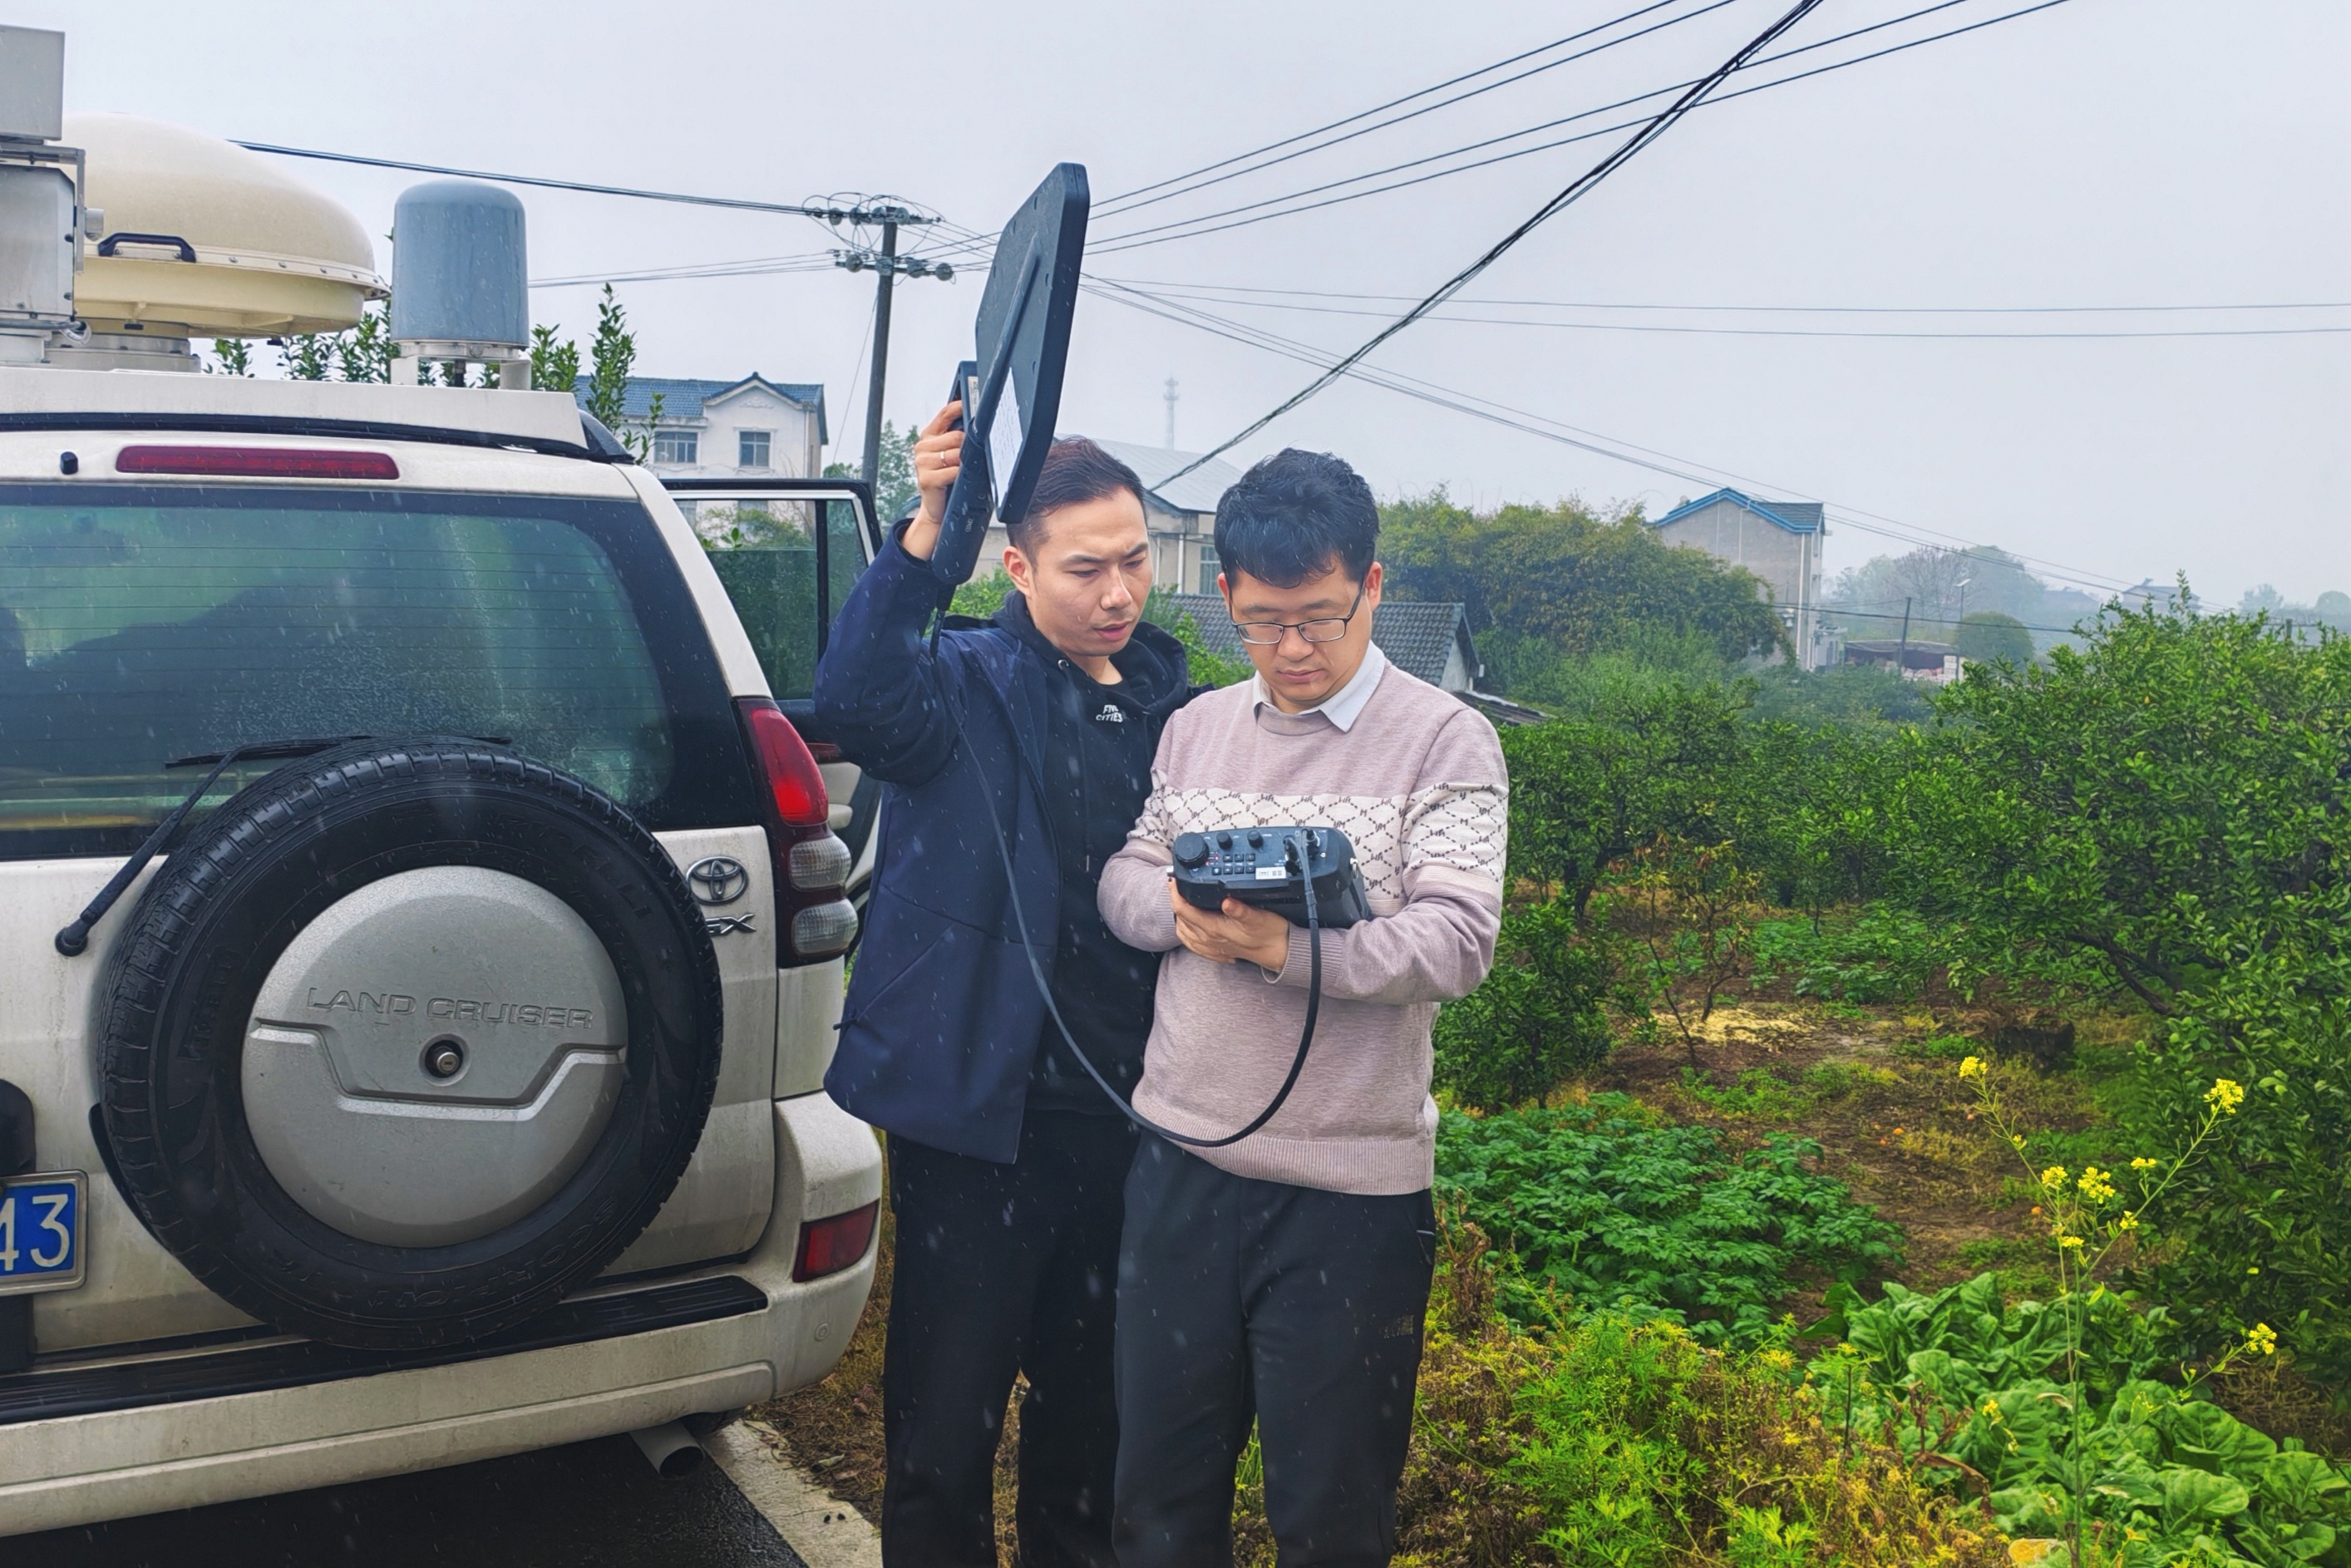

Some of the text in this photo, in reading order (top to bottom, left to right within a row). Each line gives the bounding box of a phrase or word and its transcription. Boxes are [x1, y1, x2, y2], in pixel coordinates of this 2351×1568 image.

[1095, 712, 1123, 722] CITIES
[307, 987, 594, 1029] LAND CRUISER
